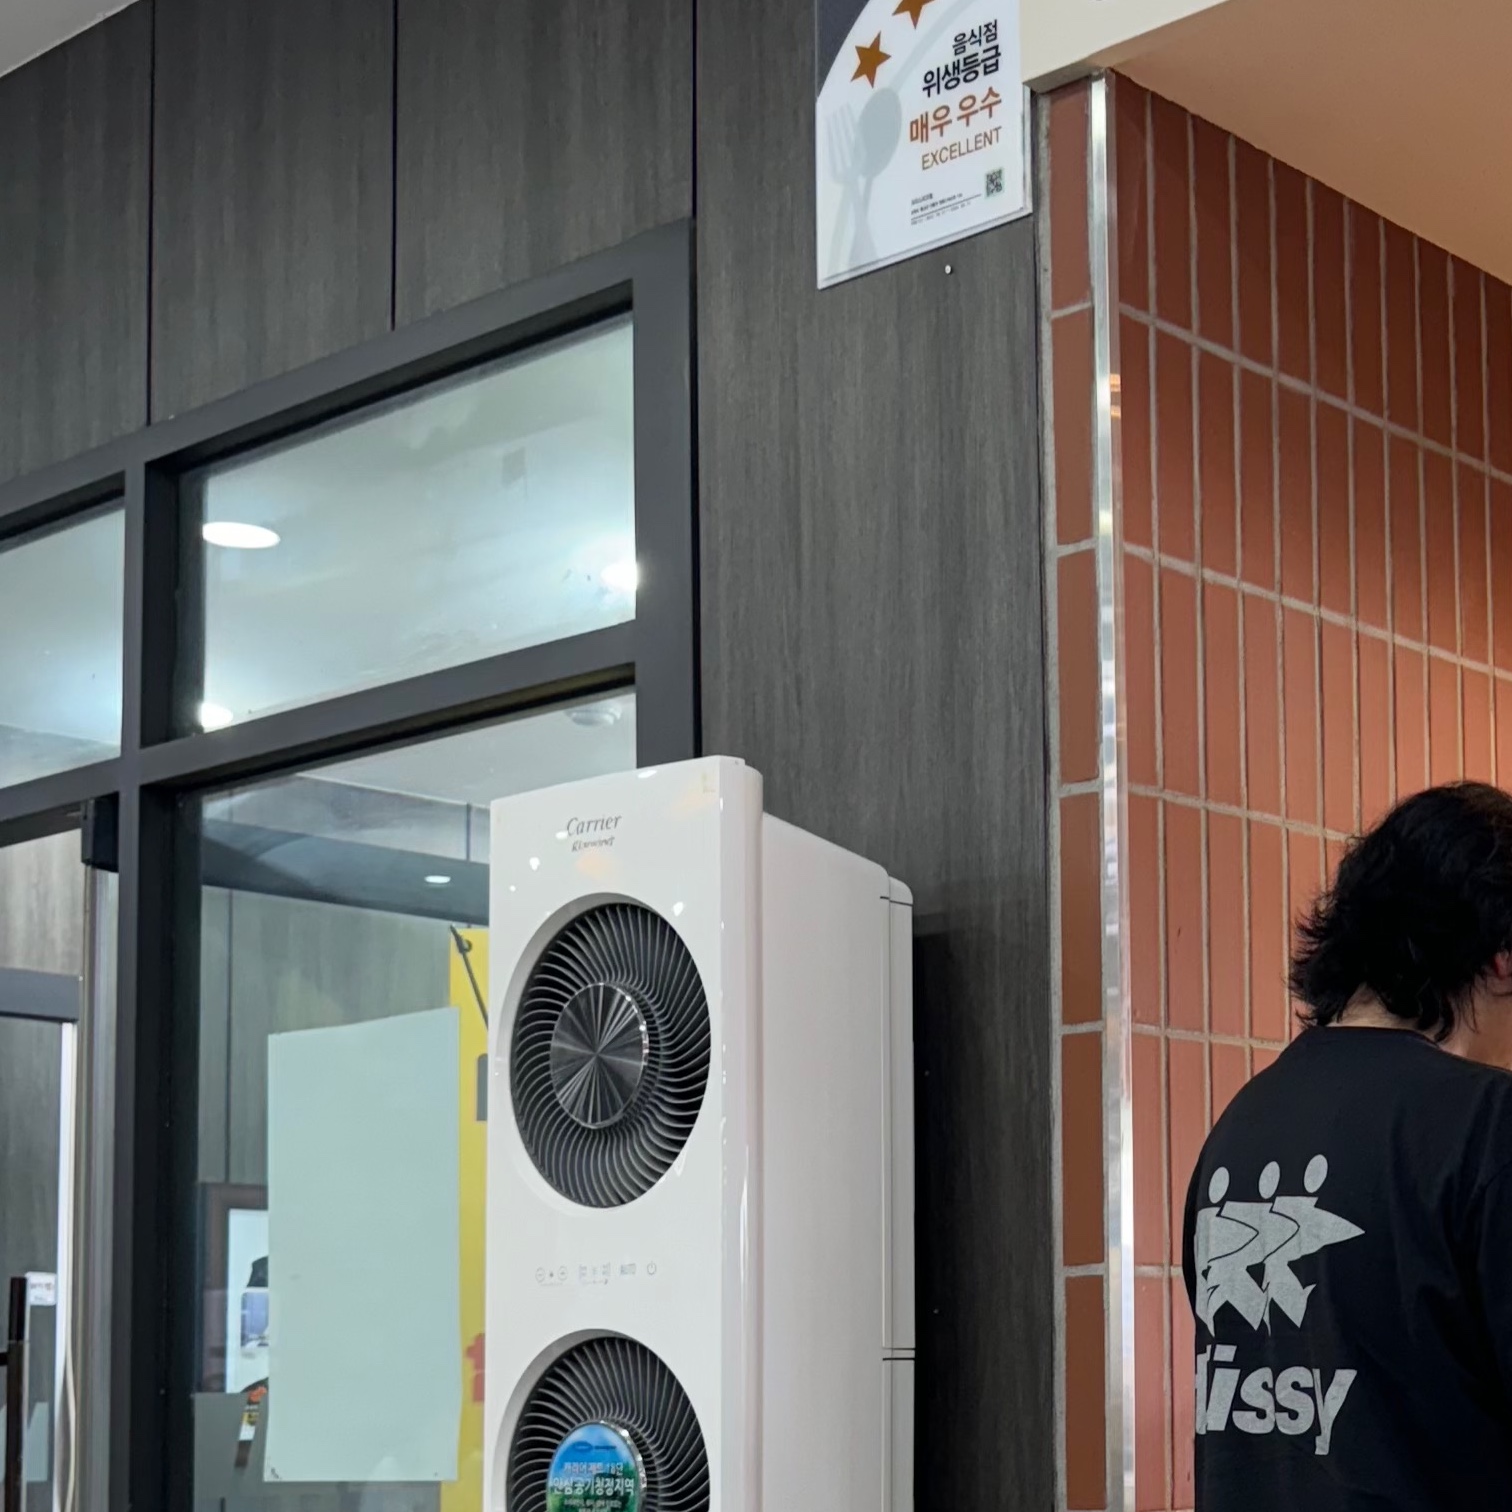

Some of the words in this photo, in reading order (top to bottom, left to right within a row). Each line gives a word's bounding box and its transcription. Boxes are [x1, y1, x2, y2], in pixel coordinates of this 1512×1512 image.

[952, 19, 998, 56] 음식점
[922, 44, 1002, 98] 위생등급
[910, 104, 953, 144] 매우
[956, 86, 1002, 128] 우수
[921, 126, 1003, 171] EXCELLENT
[566, 814, 623, 837] Carrier
